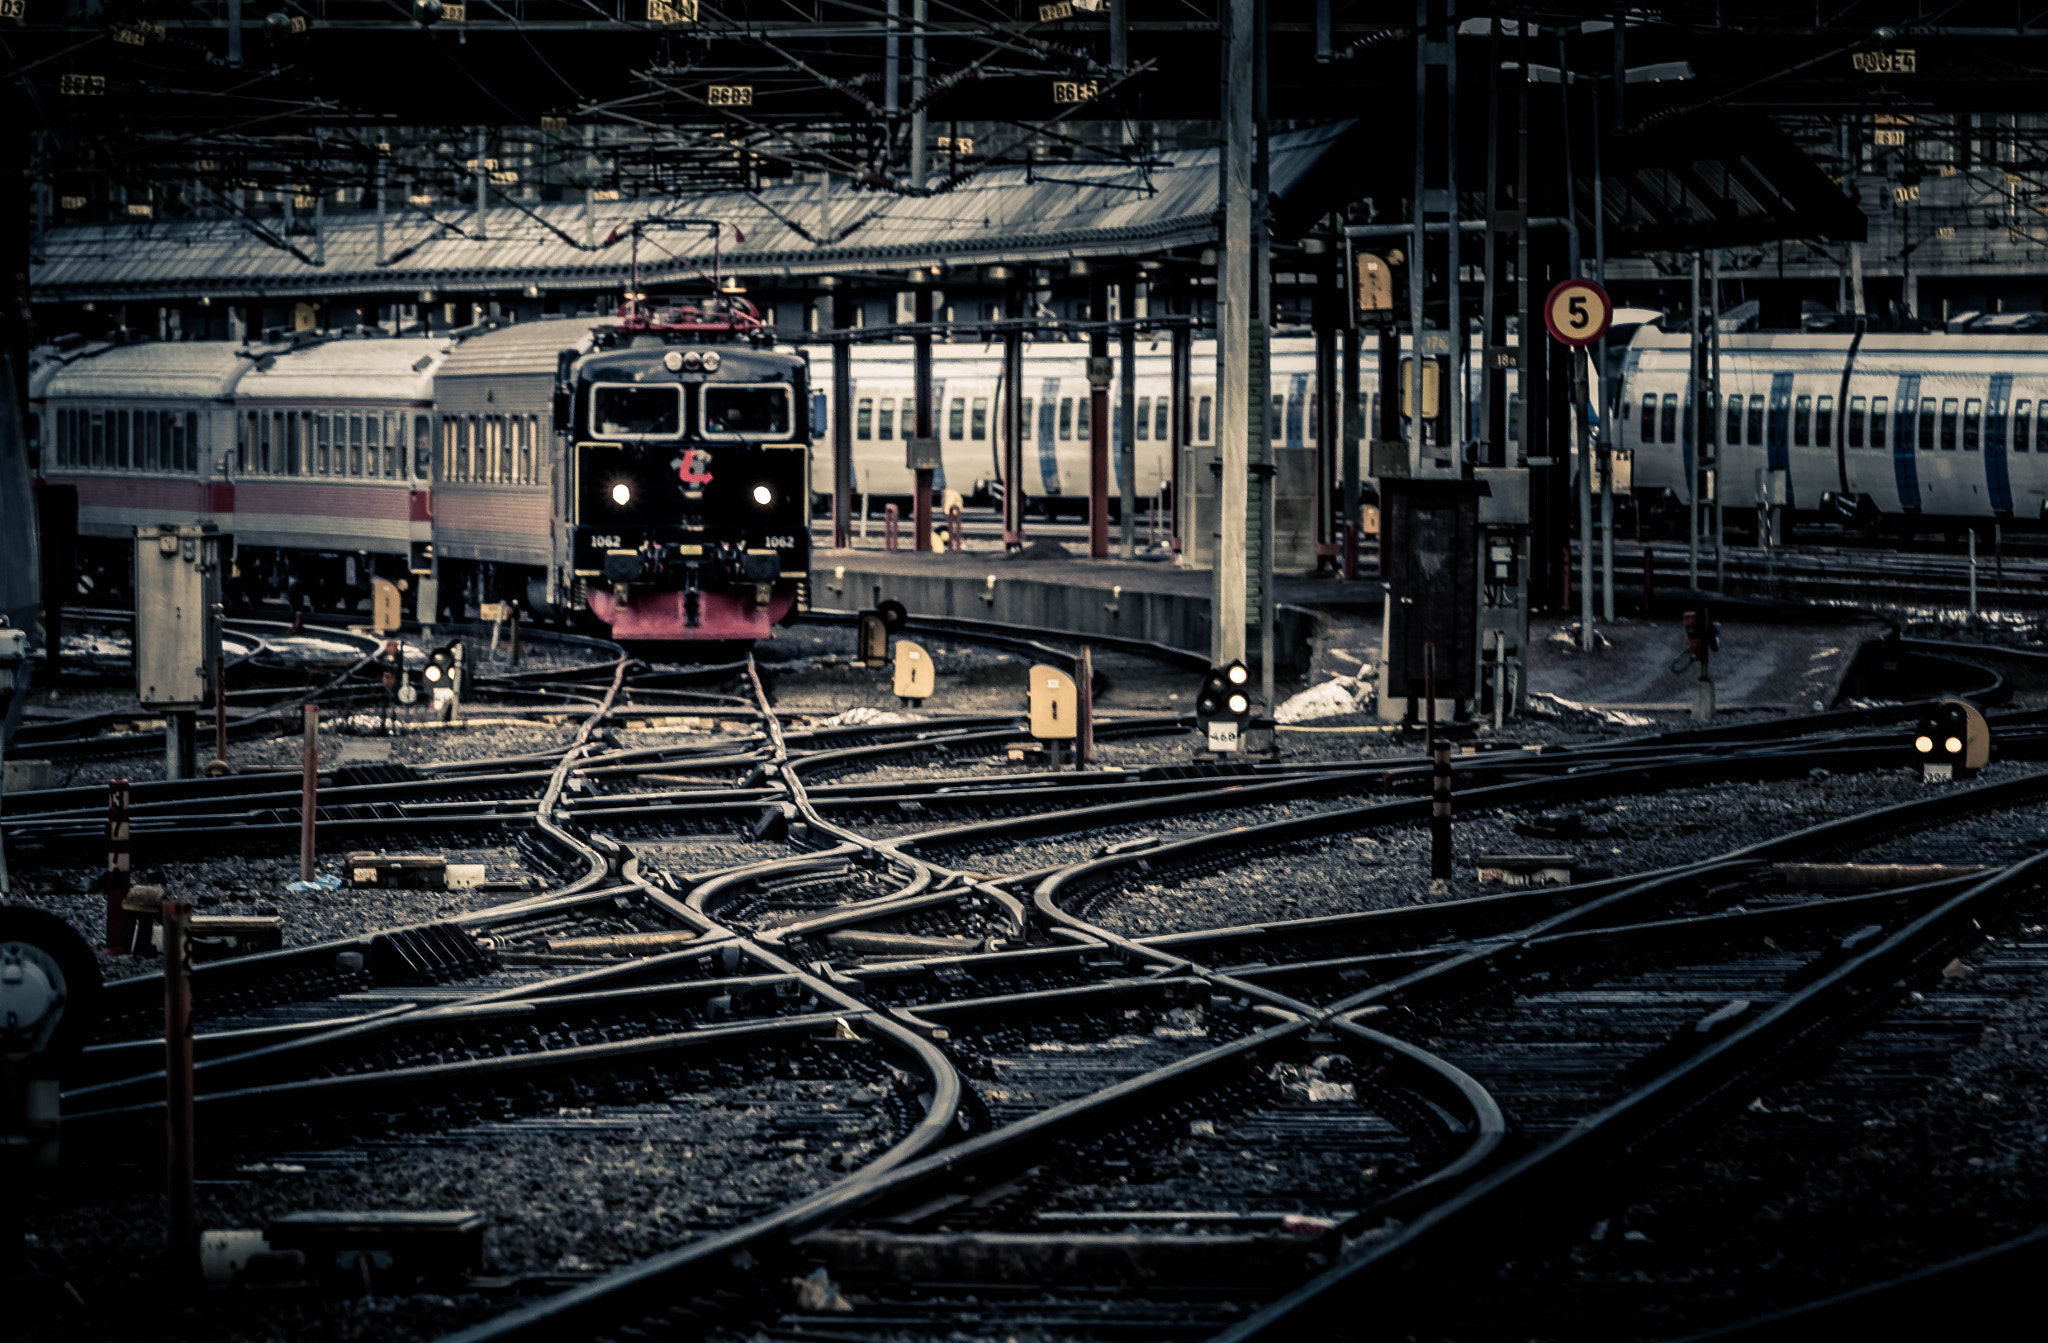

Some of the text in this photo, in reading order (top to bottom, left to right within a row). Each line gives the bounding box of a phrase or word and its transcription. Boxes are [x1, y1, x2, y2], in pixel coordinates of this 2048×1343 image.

[1569, 296, 1588, 329] 5
[591, 535, 621, 548] 1062
[765, 535, 795, 548] 1062
